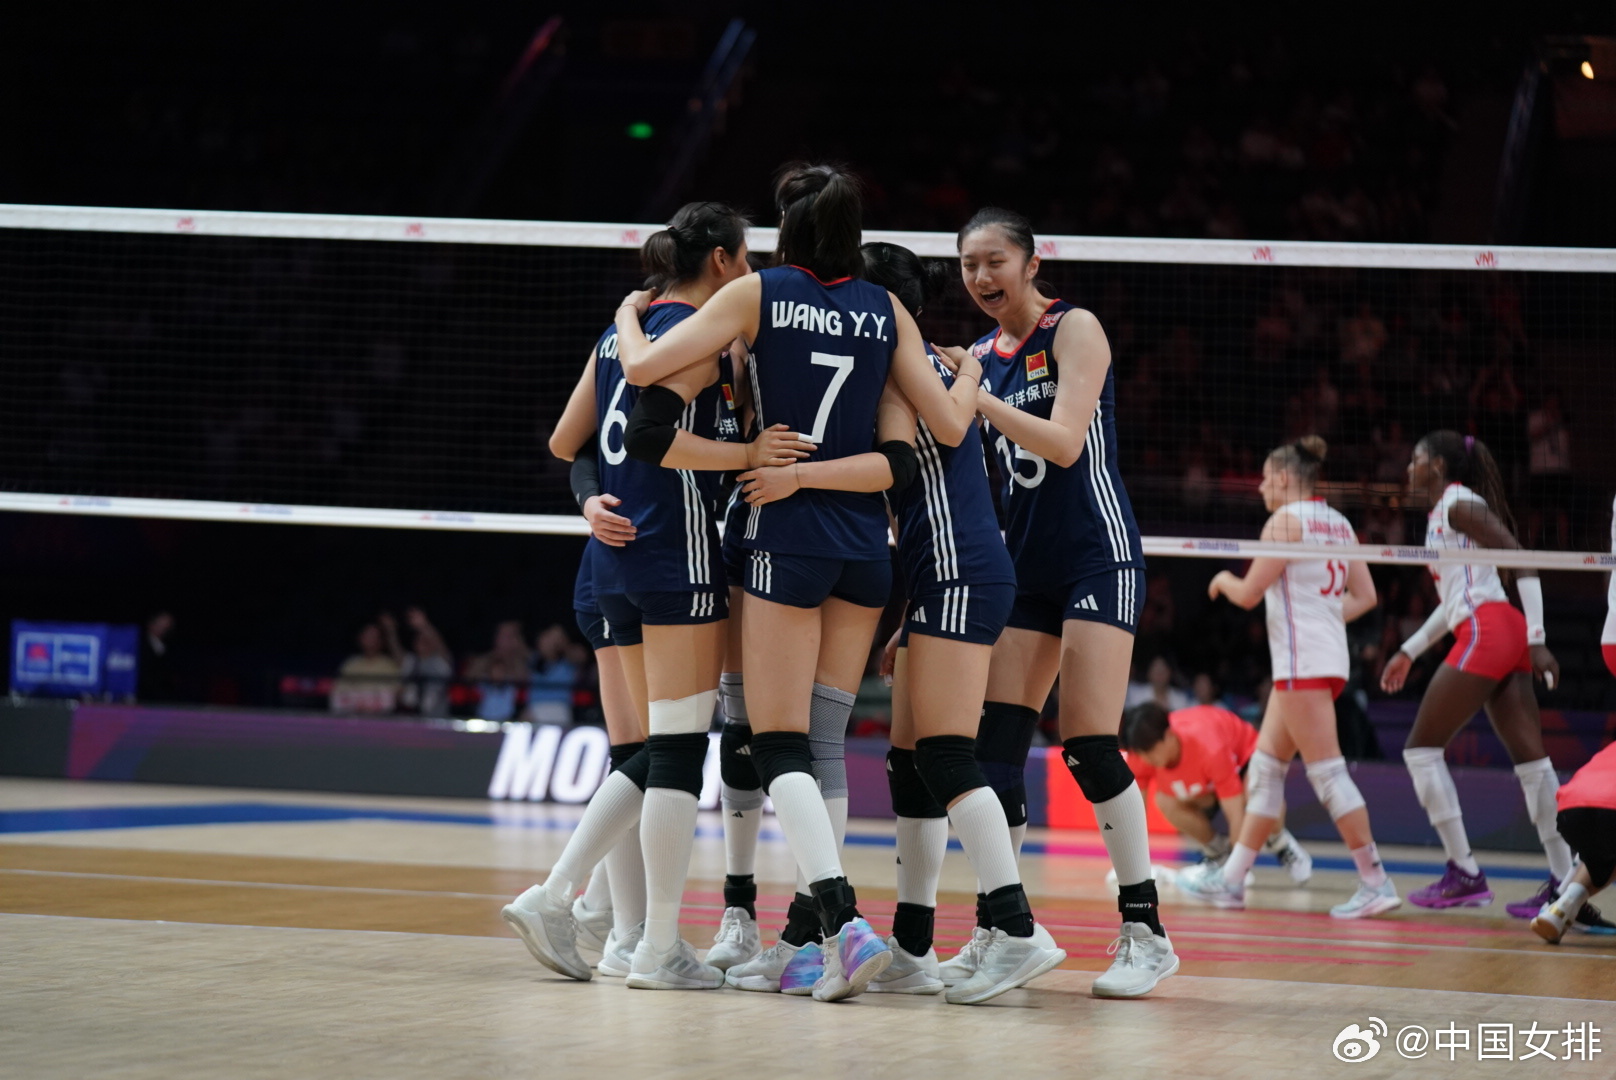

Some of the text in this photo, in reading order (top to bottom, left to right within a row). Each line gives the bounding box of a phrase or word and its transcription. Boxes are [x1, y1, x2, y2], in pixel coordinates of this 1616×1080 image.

[771, 300, 888, 342] WANG Y.Y.
[810, 351, 855, 444] 7
[1029, 367, 1047, 379] CHN
[600, 377, 628, 466] 6
[994, 434, 1047, 496] 15
[487, 724, 612, 804] MO
